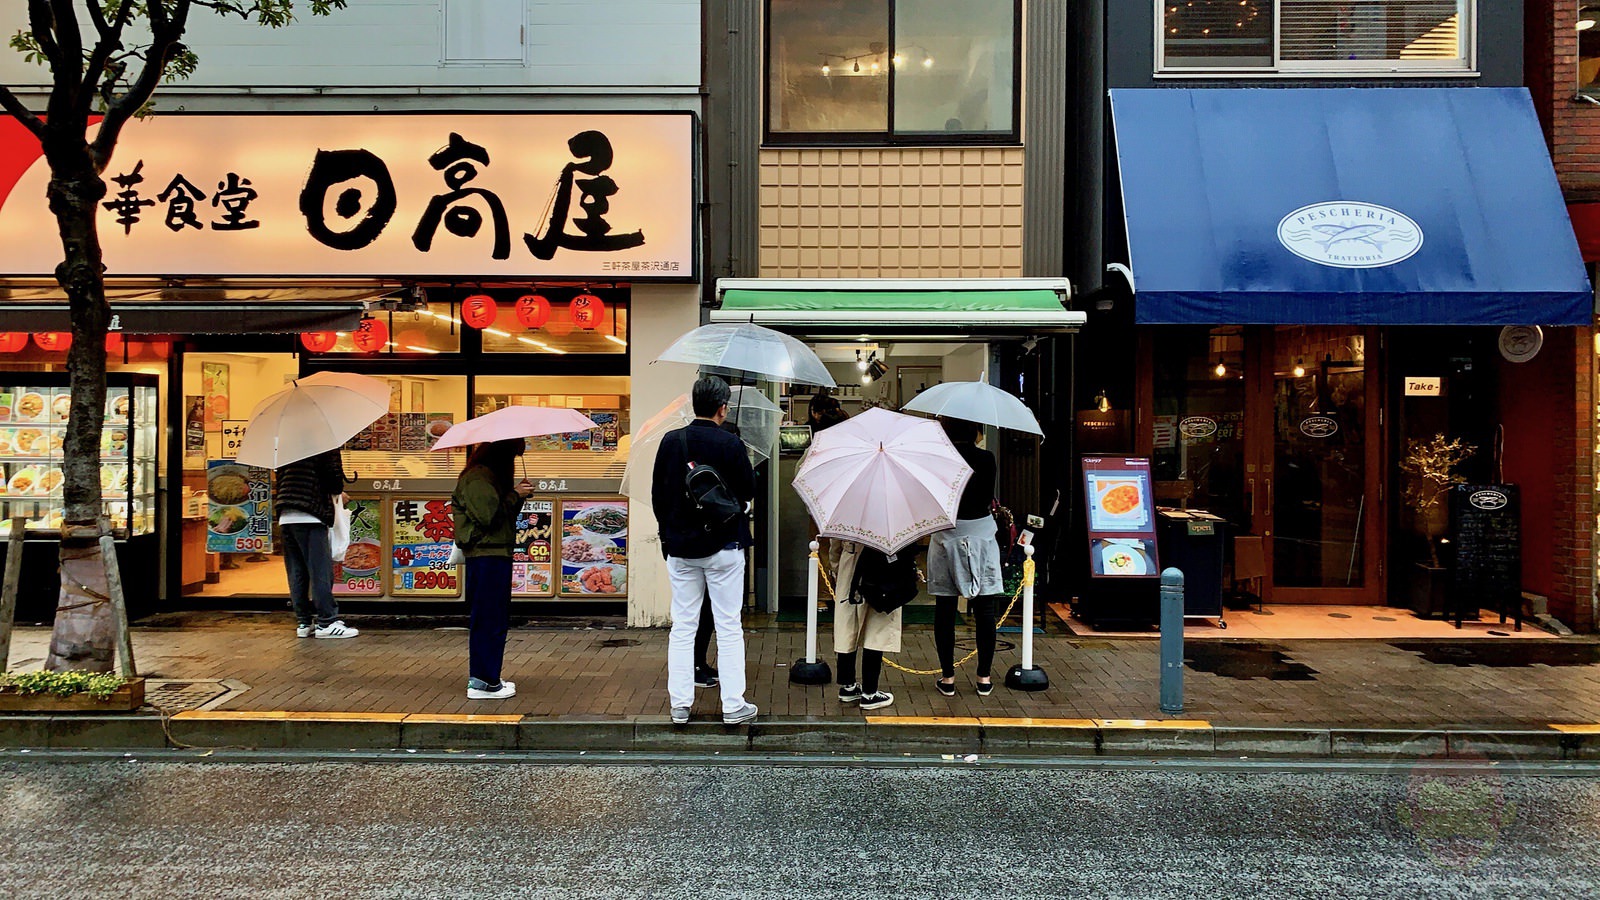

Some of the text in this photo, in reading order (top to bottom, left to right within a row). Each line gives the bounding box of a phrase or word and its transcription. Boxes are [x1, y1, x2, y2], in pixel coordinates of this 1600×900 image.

[299, 130, 645, 261] 日高屋
[1297, 208, 1396, 225] PESCHERIA
[1327, 253, 1384, 262] TRATTORIA
[602, 261, 680, 272] 三軒茶屋茶沢通店
[520, 297, 536, 323] サワー
[575, 297, 591, 322] 炒飯
[373, 479, 402, 490] 日高屋
[538, 479, 568, 491] 日高屋
[248, 480, 270, 536] 冷し麺
[414, 571, 457, 589] 290円
